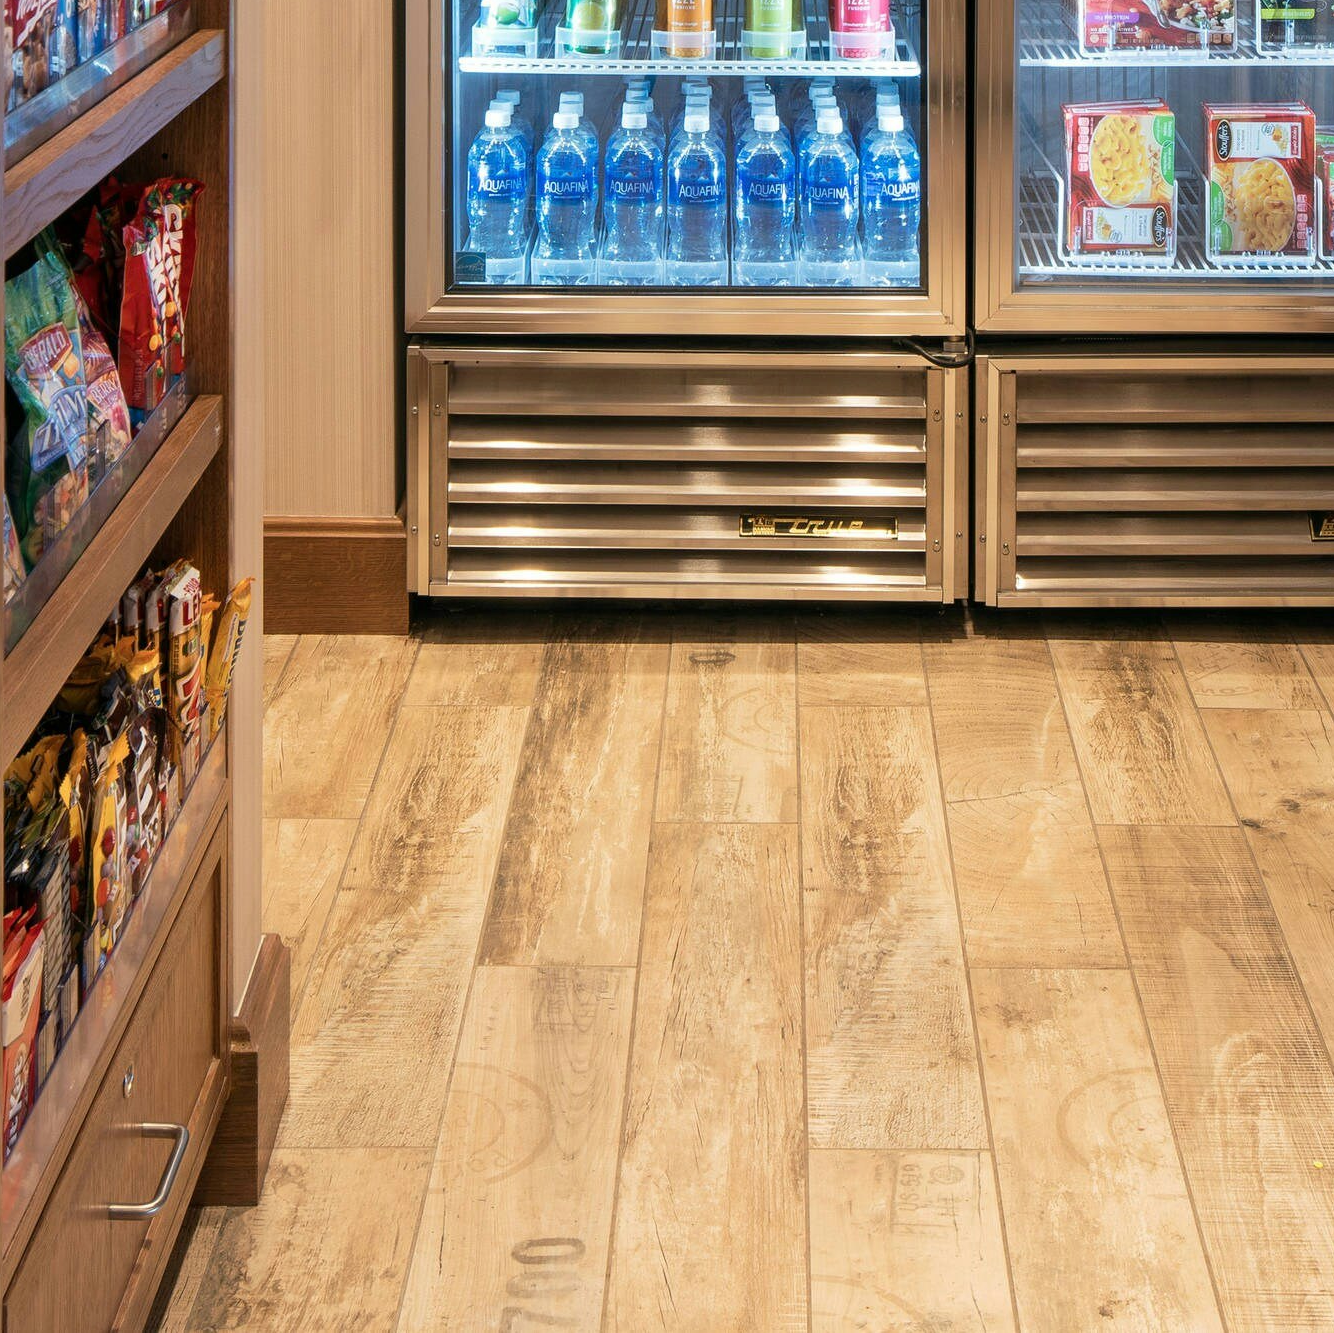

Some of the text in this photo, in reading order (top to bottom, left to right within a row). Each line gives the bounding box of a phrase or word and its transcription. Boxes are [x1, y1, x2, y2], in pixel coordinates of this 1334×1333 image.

[1218, 122, 1229, 157] Stouffer's
[478, 178, 524, 195] AQUAFINA
[544, 180, 590, 195] AQUAFINA
[610, 180, 655, 195] AQUAFINA
[805, 185, 850, 200] AQUAFINA
[91, 378, 120, 403] BERRY
